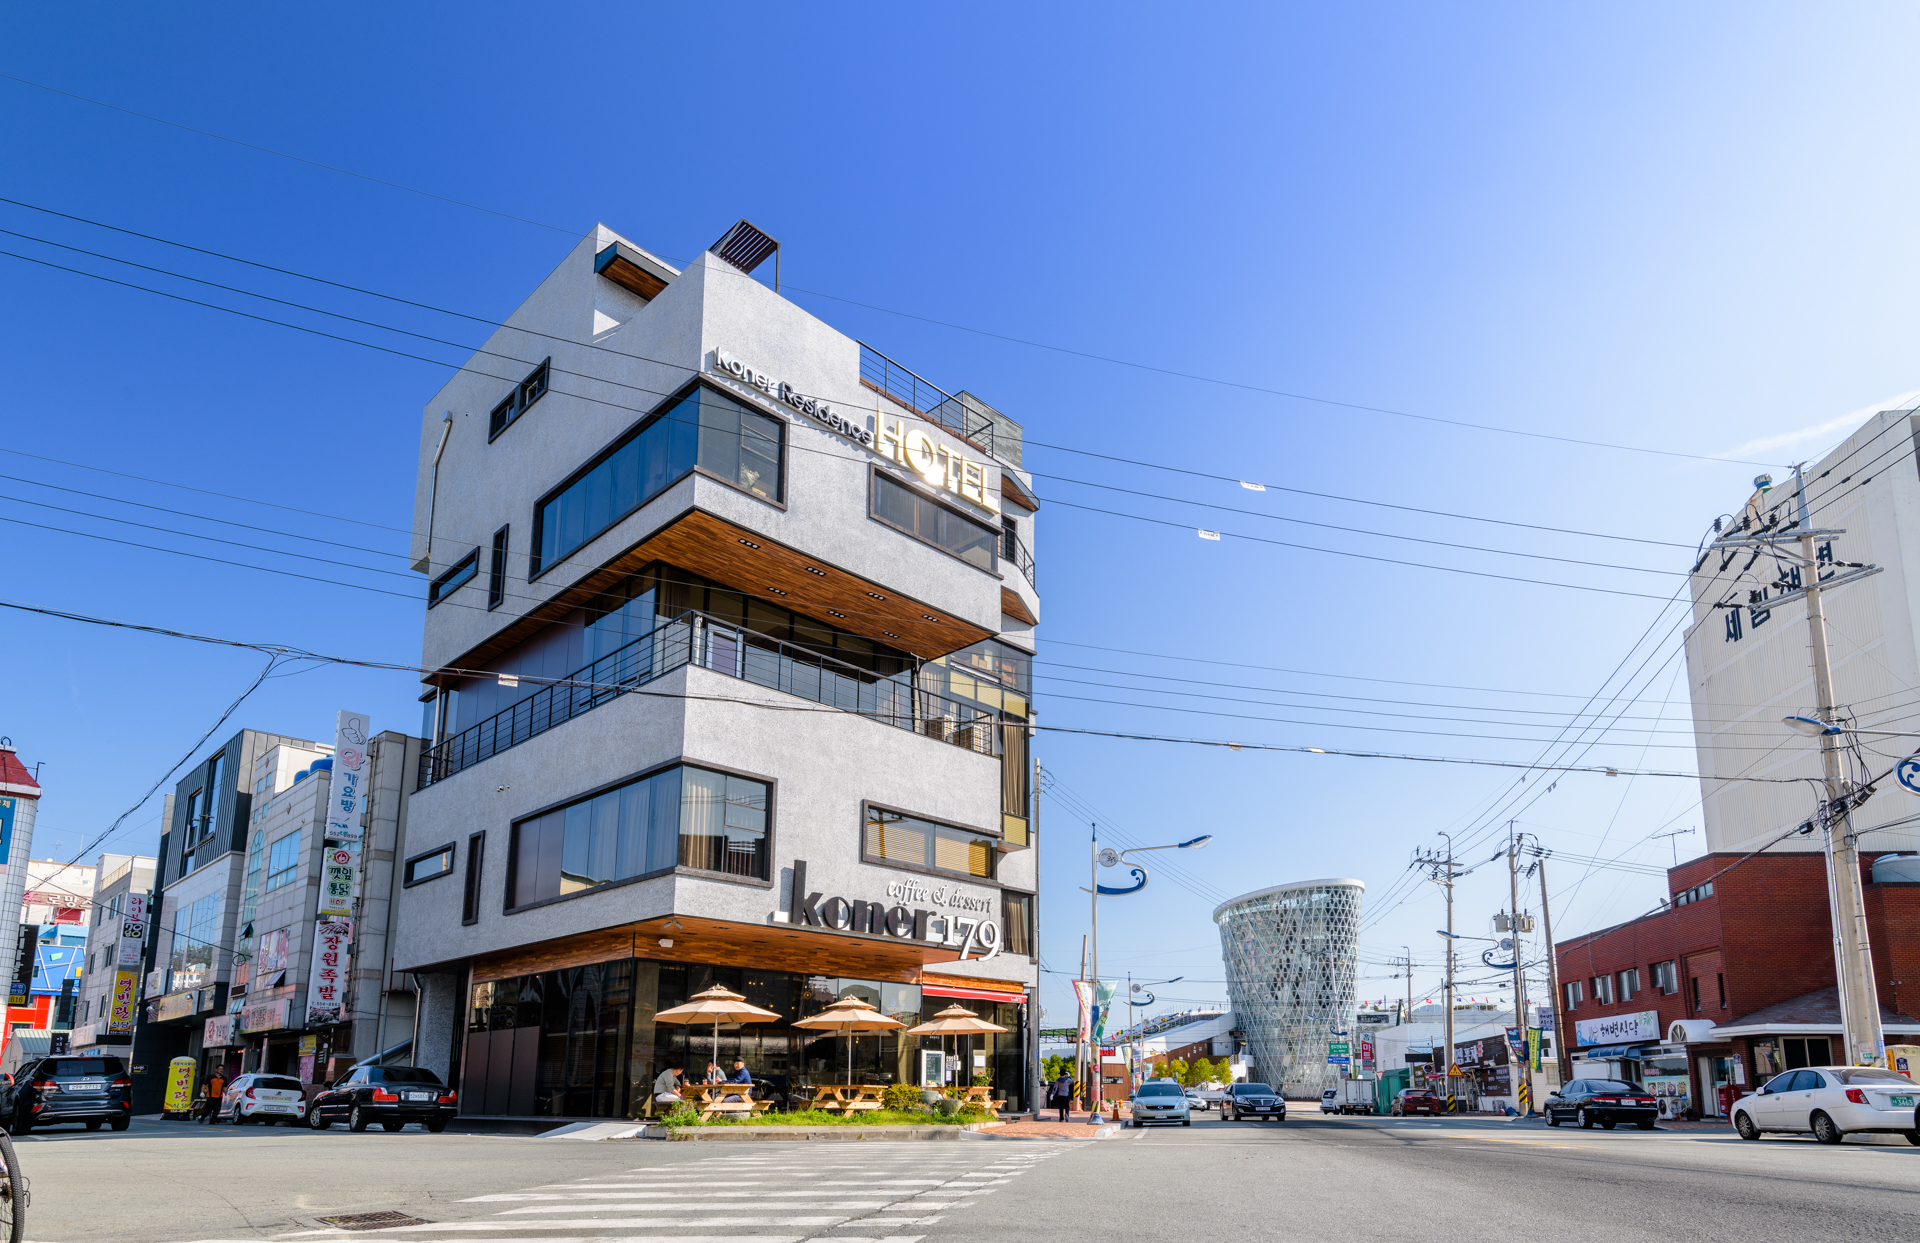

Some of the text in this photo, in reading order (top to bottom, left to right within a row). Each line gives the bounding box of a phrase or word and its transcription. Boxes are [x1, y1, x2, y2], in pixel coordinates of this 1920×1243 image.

[716, 346, 874, 445] Koner Residence
[876, 409, 1001, 515] HOTEL
[340, 747, 365, 814] 왕 가요방
[0, 799, 12, 809] 체
[328, 866, 352, 881] 깻잎
[329, 881, 350, 897] 통닭
[887, 879, 993, 913] coffee & dessert
[130, 897, 144, 922] 라이브
[791, 859, 1001, 961] koner 179
[318, 935, 343, 1001] 장원족발
[111, 1021, 131, 1029] 식당
[1599, 1019, 1639, 1038] 해변식당
